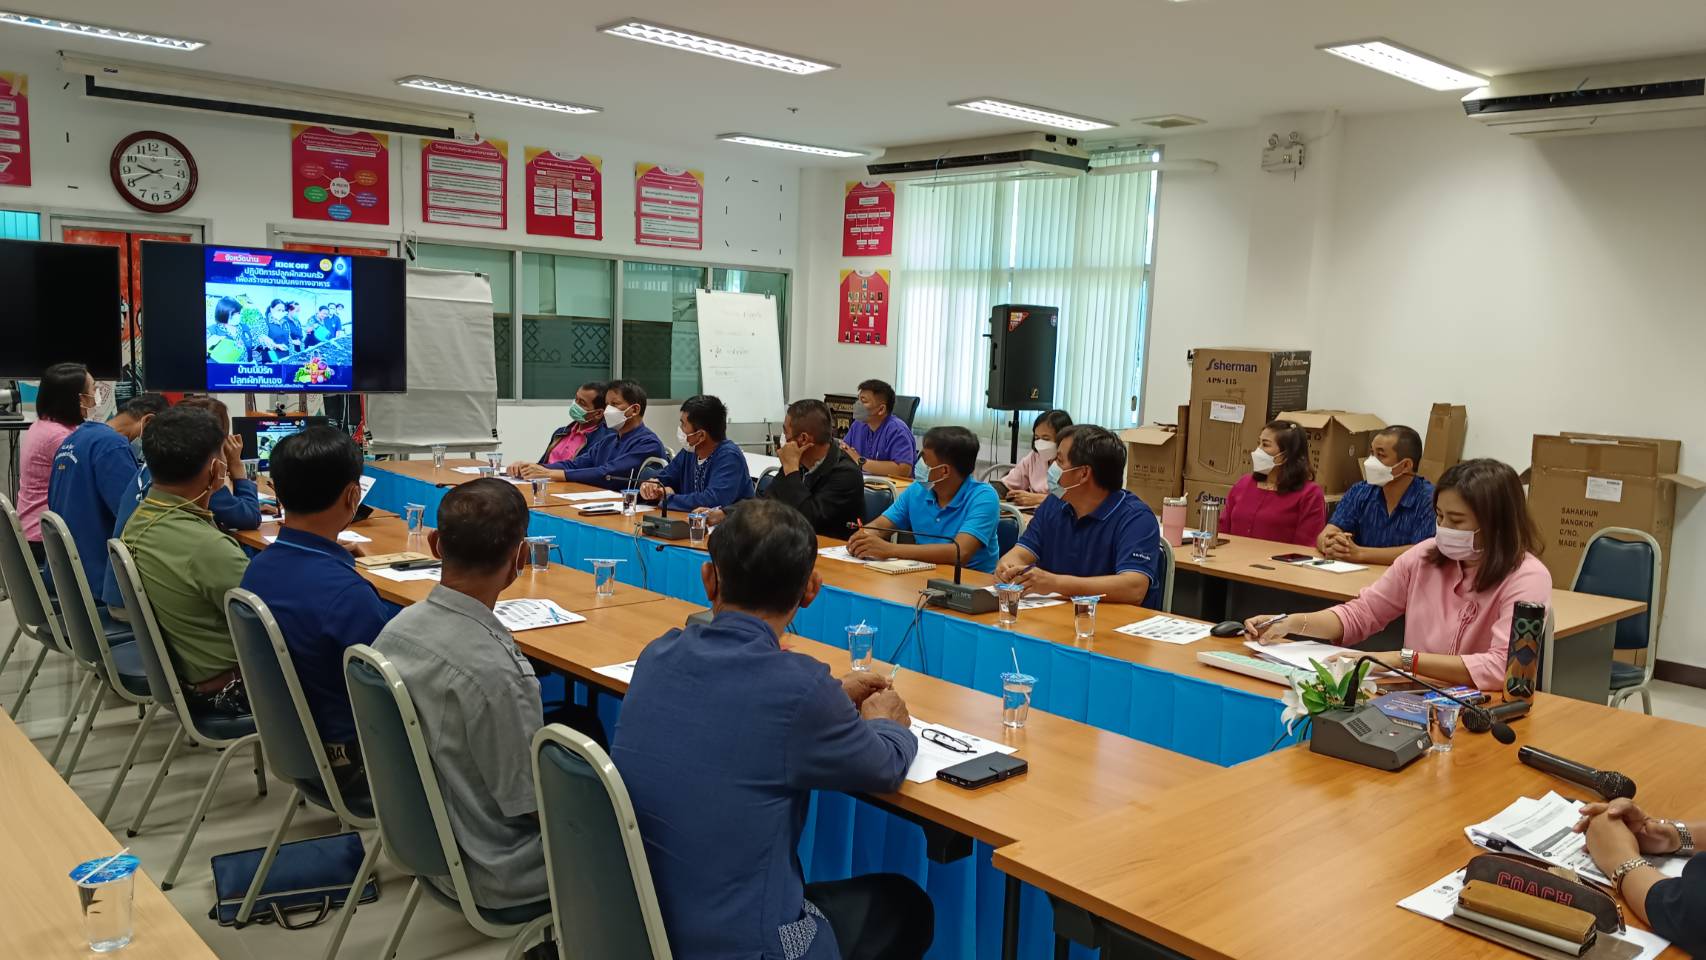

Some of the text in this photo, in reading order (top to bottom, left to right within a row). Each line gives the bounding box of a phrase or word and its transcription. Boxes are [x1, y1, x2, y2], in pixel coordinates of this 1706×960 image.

[137, 145, 146, 155] 11
[147, 142, 159, 152] 12
[164, 147, 169, 157] 1
[127, 155, 138, 163] 10
[173, 159, 181, 167] 2
[122, 166, 131, 175] 9
[177, 170, 186, 178] 3
[127, 178, 136, 187] 8
[172, 182, 180, 191] 4
[139, 189, 147, 198] 7
[151, 192, 160, 201] 6
[163, 190, 172, 199] 5
[224, 253, 259, 263] จังหวัดน่าน
[295, 262, 310, 270] OFF
[1561, 507, 1599, 518] SAHAKHUN
[1560, 518, 1594, 528] BANGKOK
[1558, 539, 1577, 548] MADE
[1497, 871, 1573, 906] COACH
